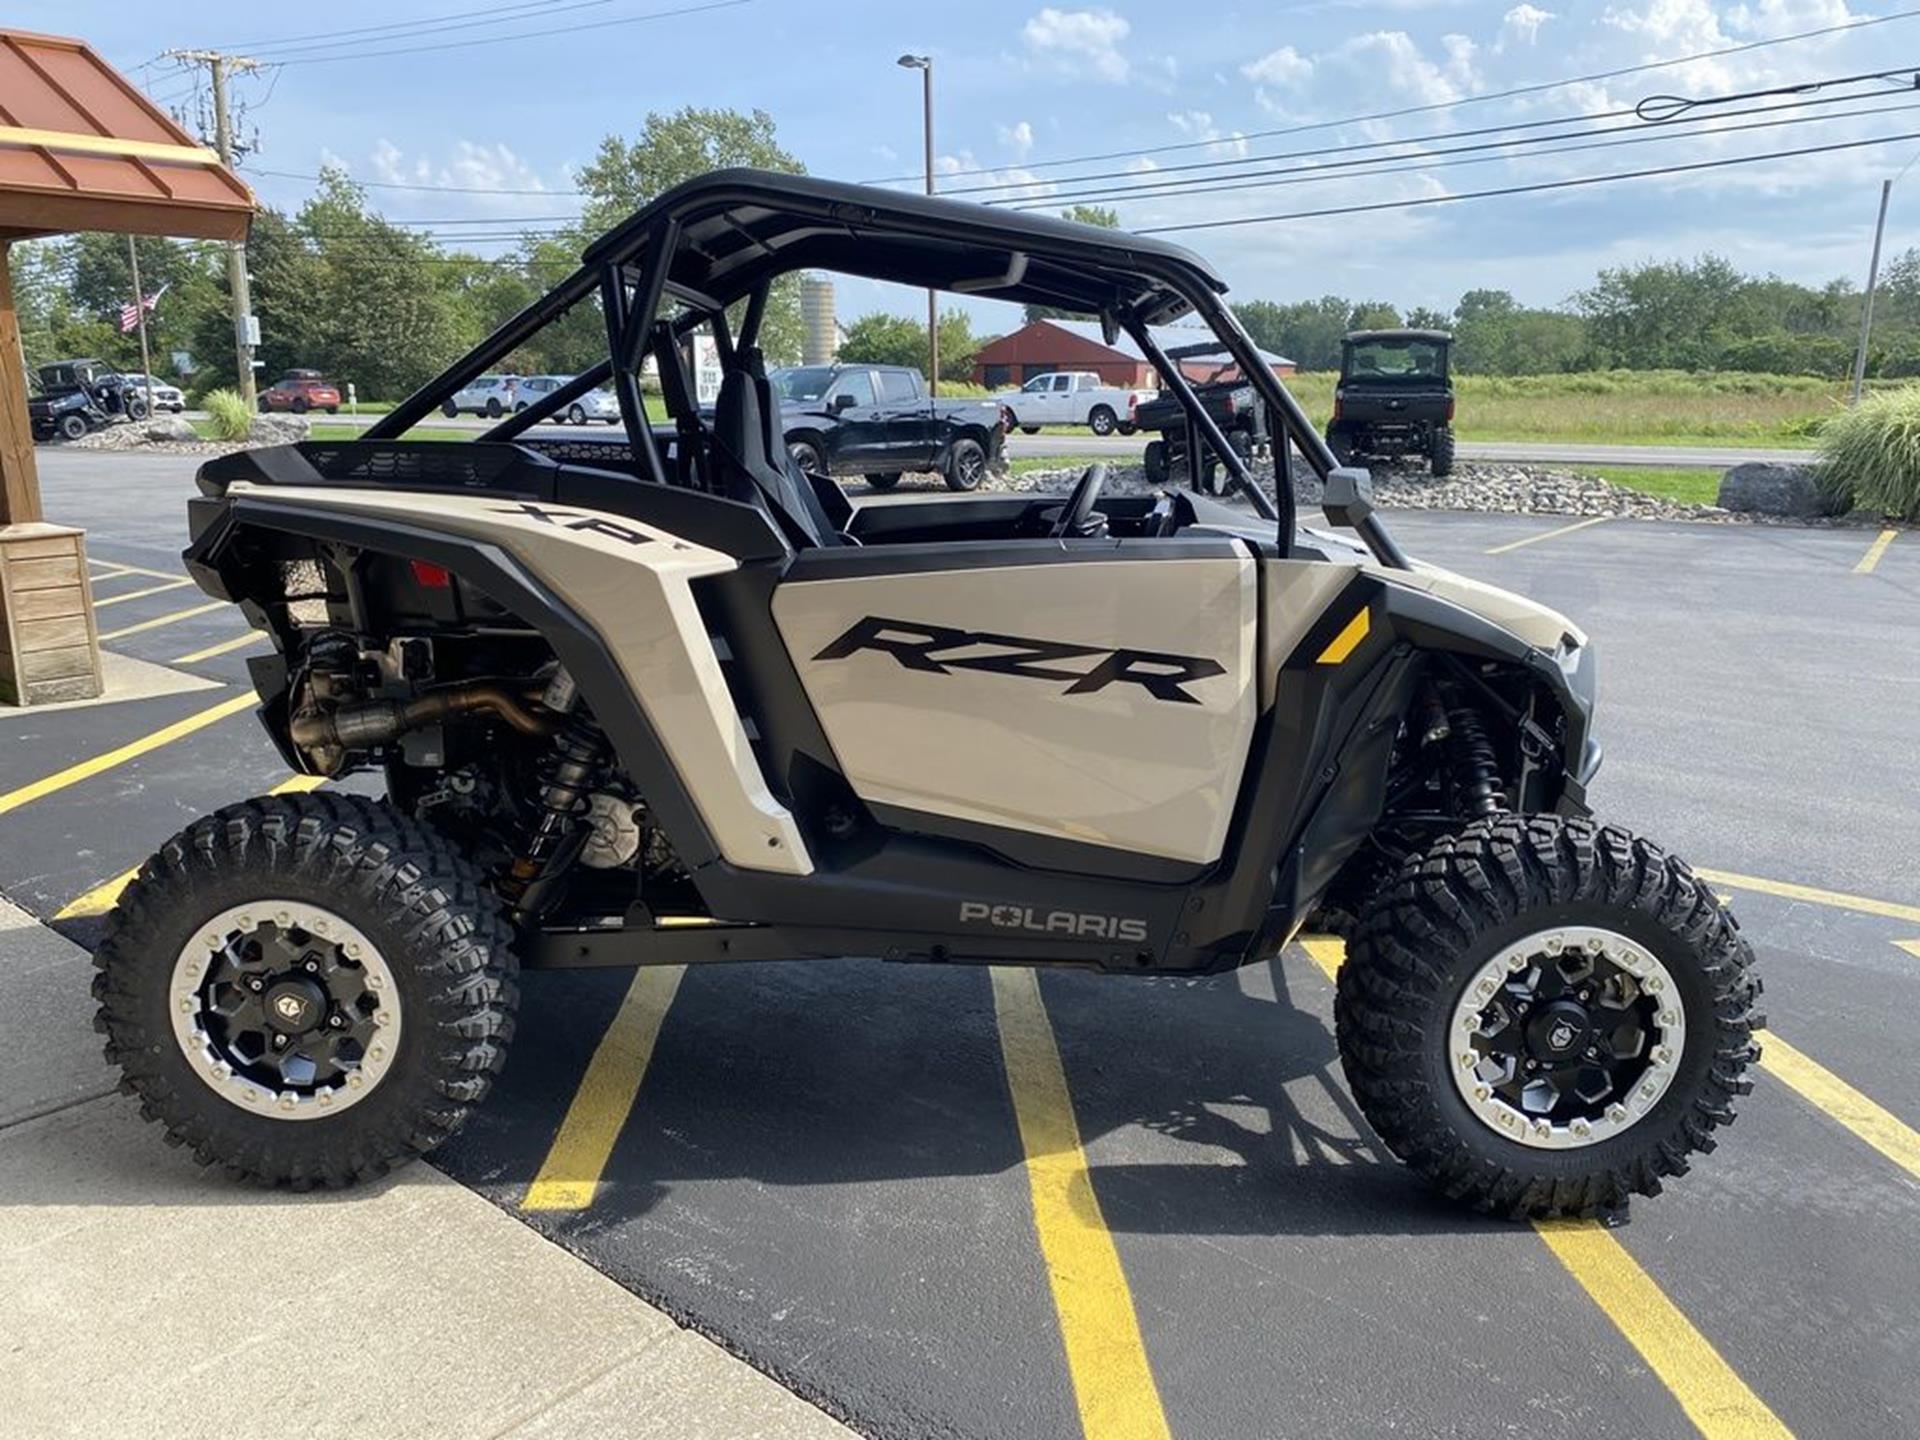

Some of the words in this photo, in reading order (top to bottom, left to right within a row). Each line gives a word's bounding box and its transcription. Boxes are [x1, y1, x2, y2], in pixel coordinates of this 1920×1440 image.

[485, 503, 656, 545] XP
[811, 615, 1228, 705] RZR
[959, 901, 1148, 942] POLARIS
